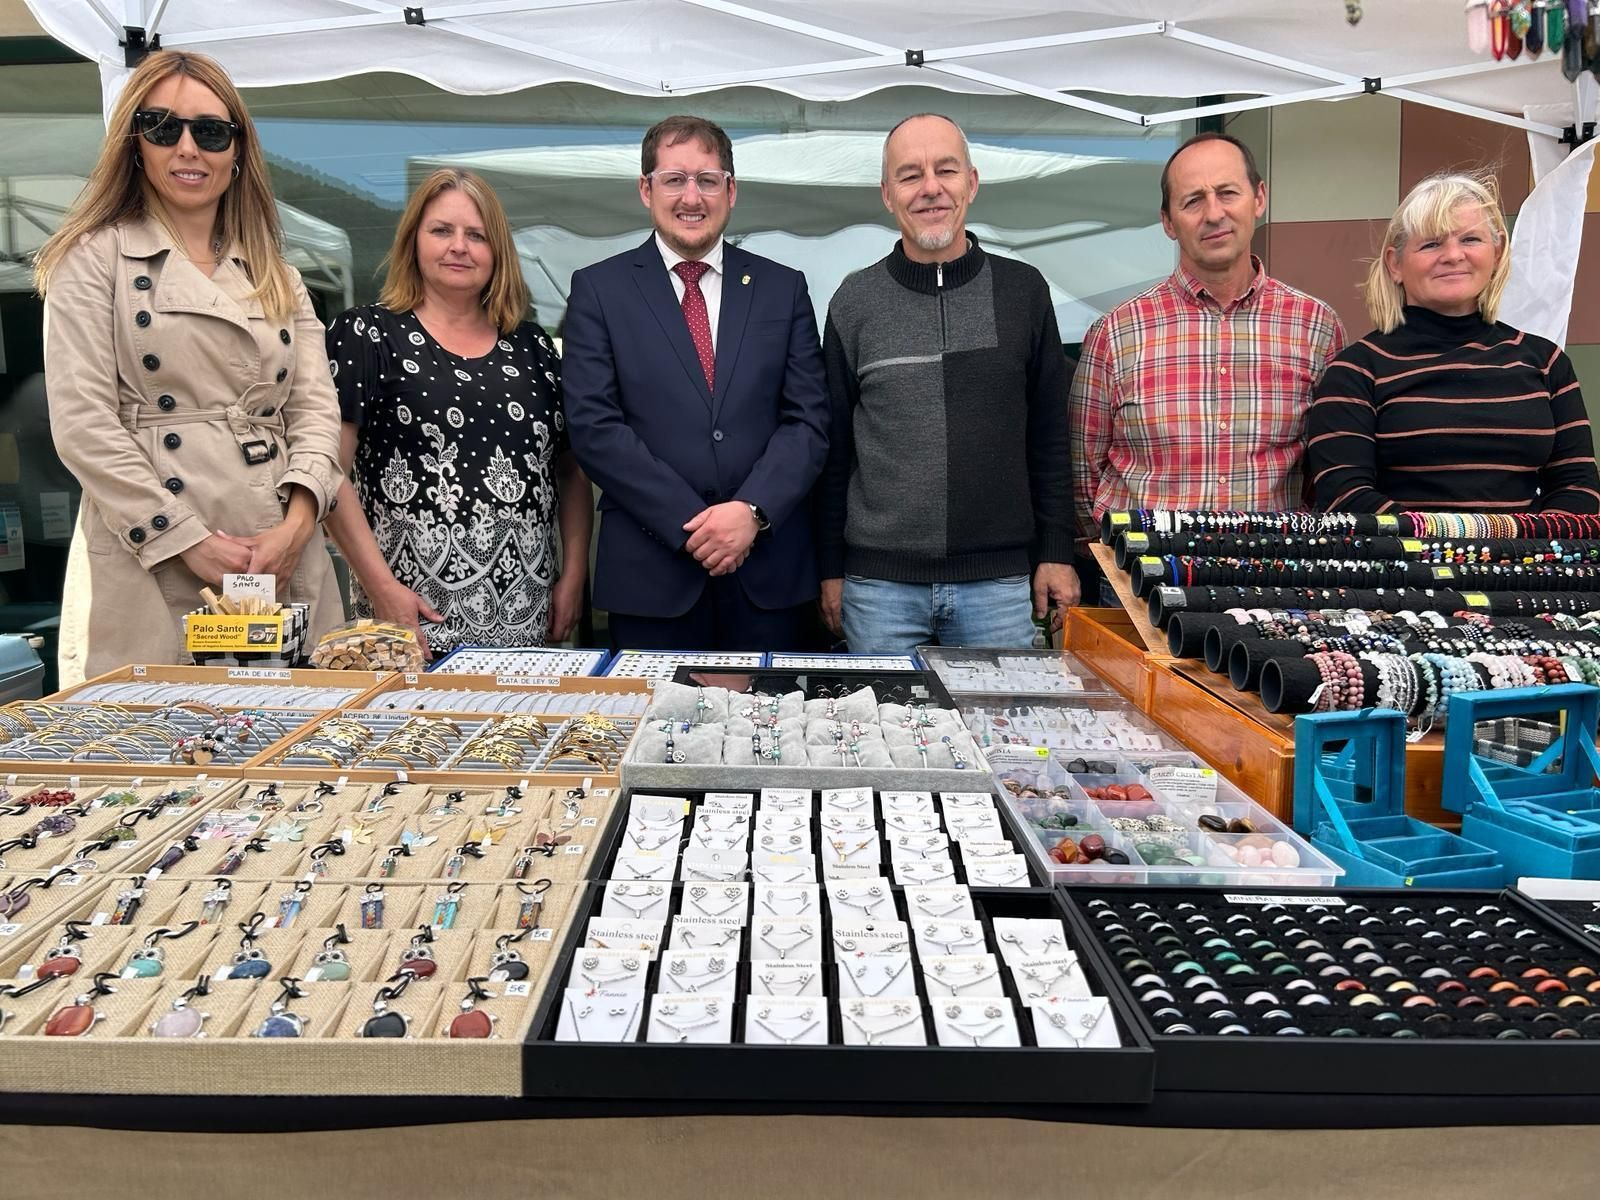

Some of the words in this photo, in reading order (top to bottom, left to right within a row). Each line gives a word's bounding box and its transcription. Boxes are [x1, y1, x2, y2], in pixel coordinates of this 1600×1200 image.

[237, 574, 254, 582] PALO
[193, 624, 214, 632] Palo
[217, 624, 244, 633] Santo
[696, 807, 731, 815] Stainless
[731, 808, 750, 816] steel
[673, 915, 718, 924] Stainless
[720, 916, 741, 925] steel
[533, 930, 549, 938] 5€
[589, 928, 634, 939] Stainless
[635, 932, 659, 941] steel
[835, 928, 879, 939] Stainless
[880, 930, 903, 939] steel
[508, 983, 527, 994] 5€
